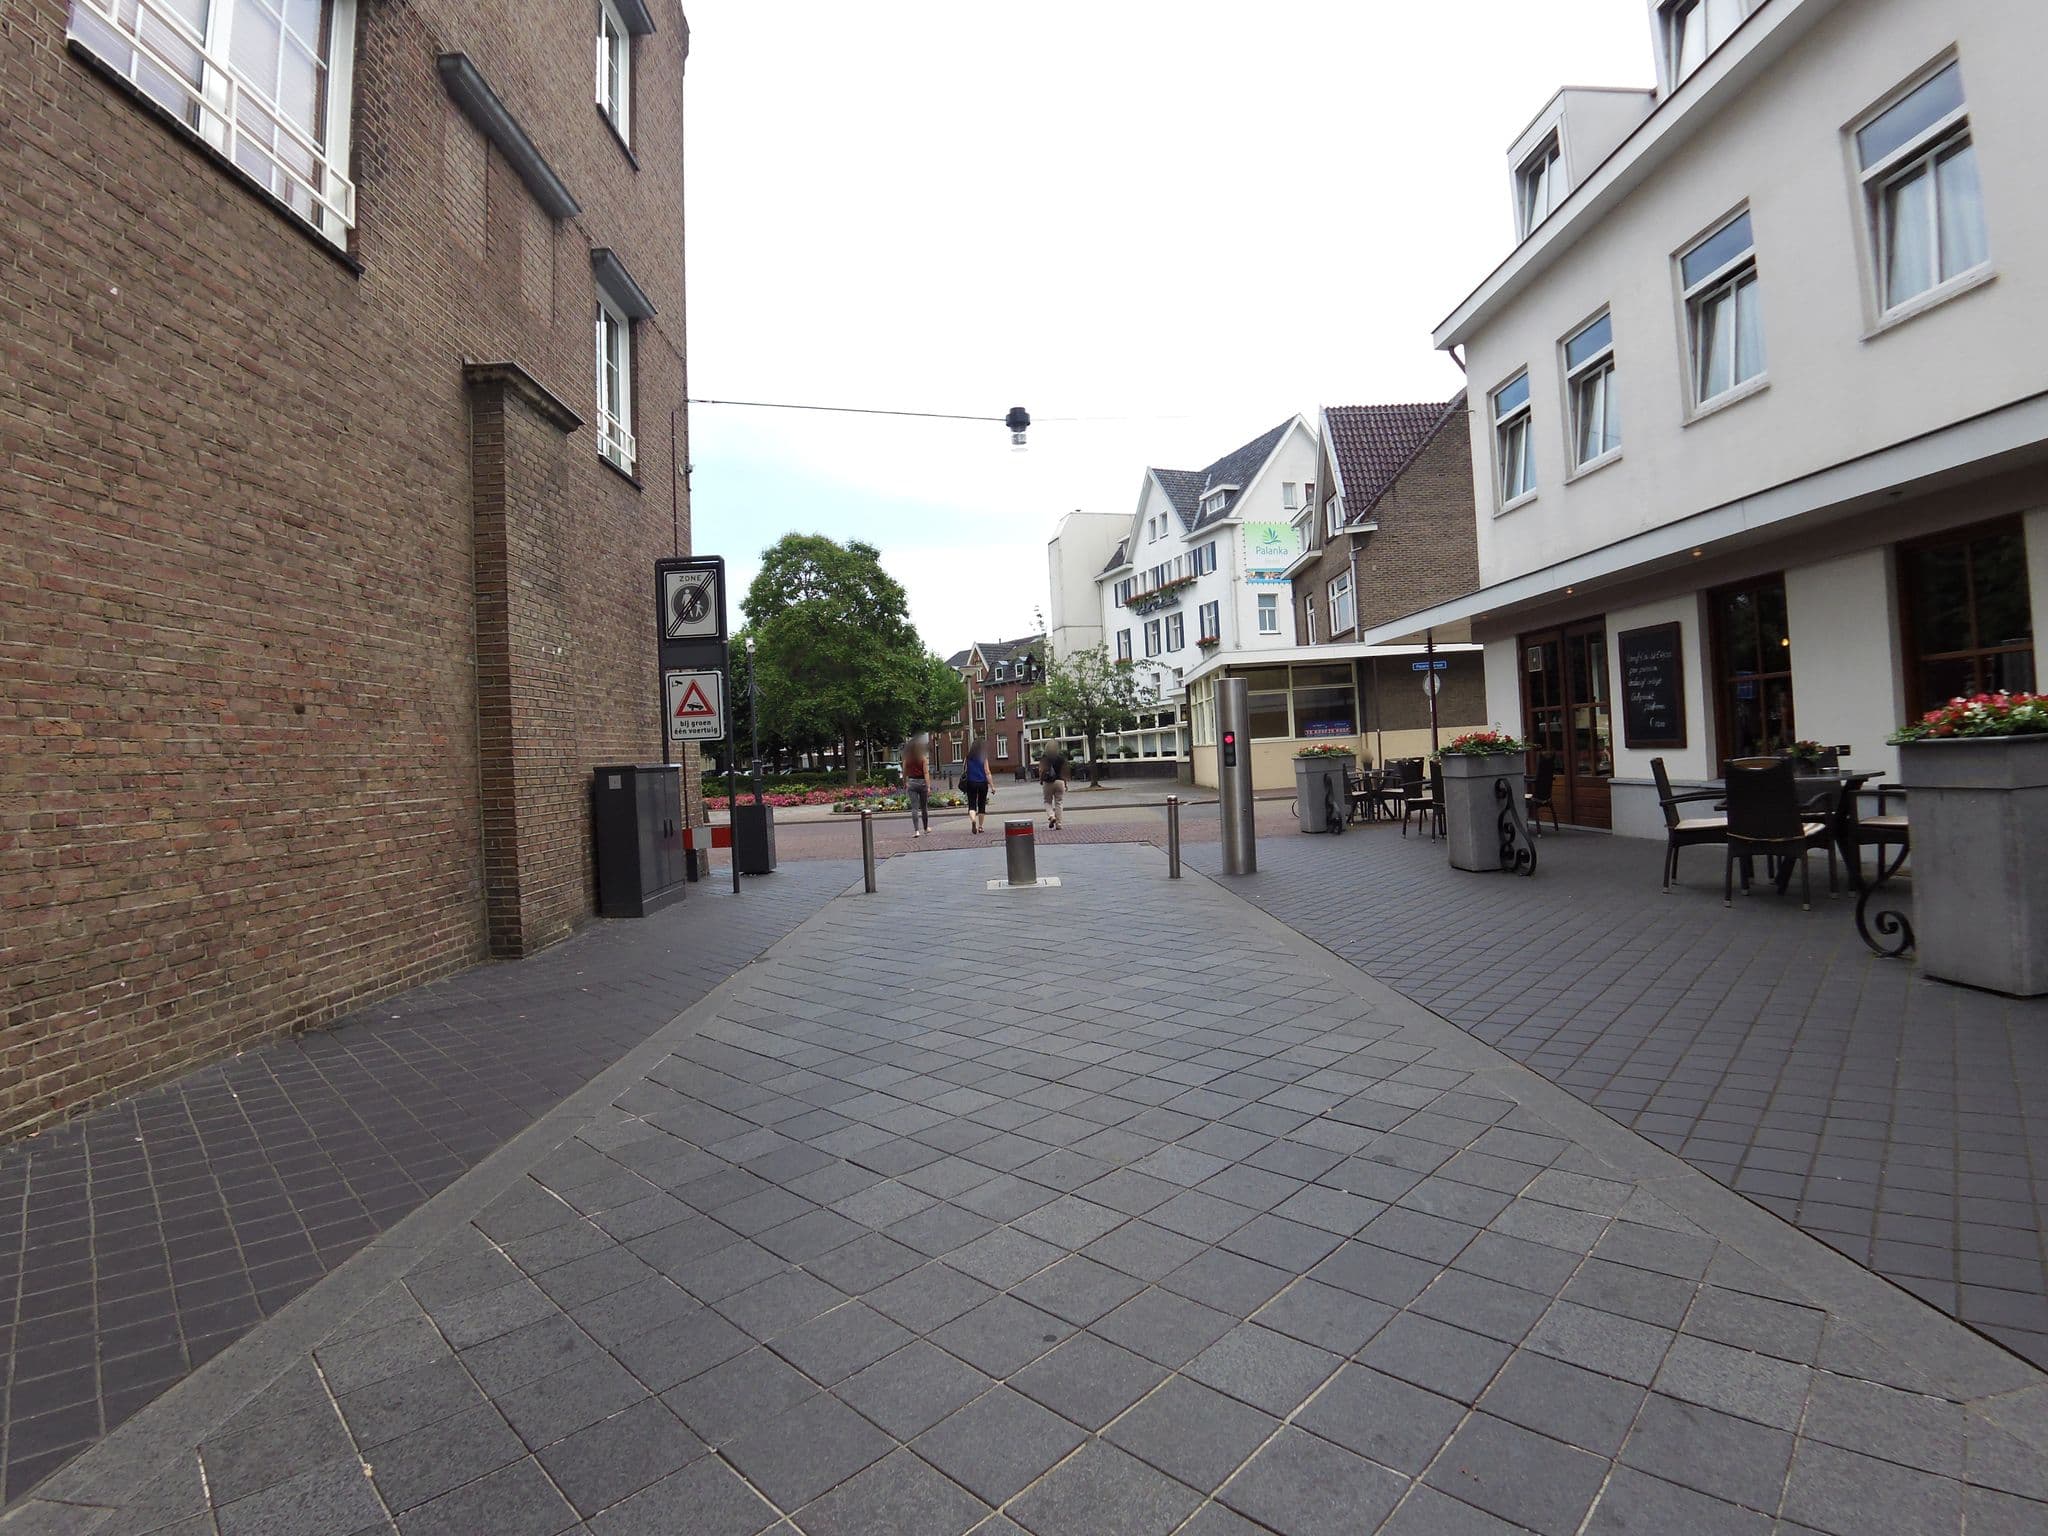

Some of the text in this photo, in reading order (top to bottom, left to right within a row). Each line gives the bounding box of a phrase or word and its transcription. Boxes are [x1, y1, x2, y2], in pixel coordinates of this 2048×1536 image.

[1256, 546, 1288, 555] Palanka
[680, 720, 711, 728] bij groen
[674, 726, 718, 735] één voertuig
